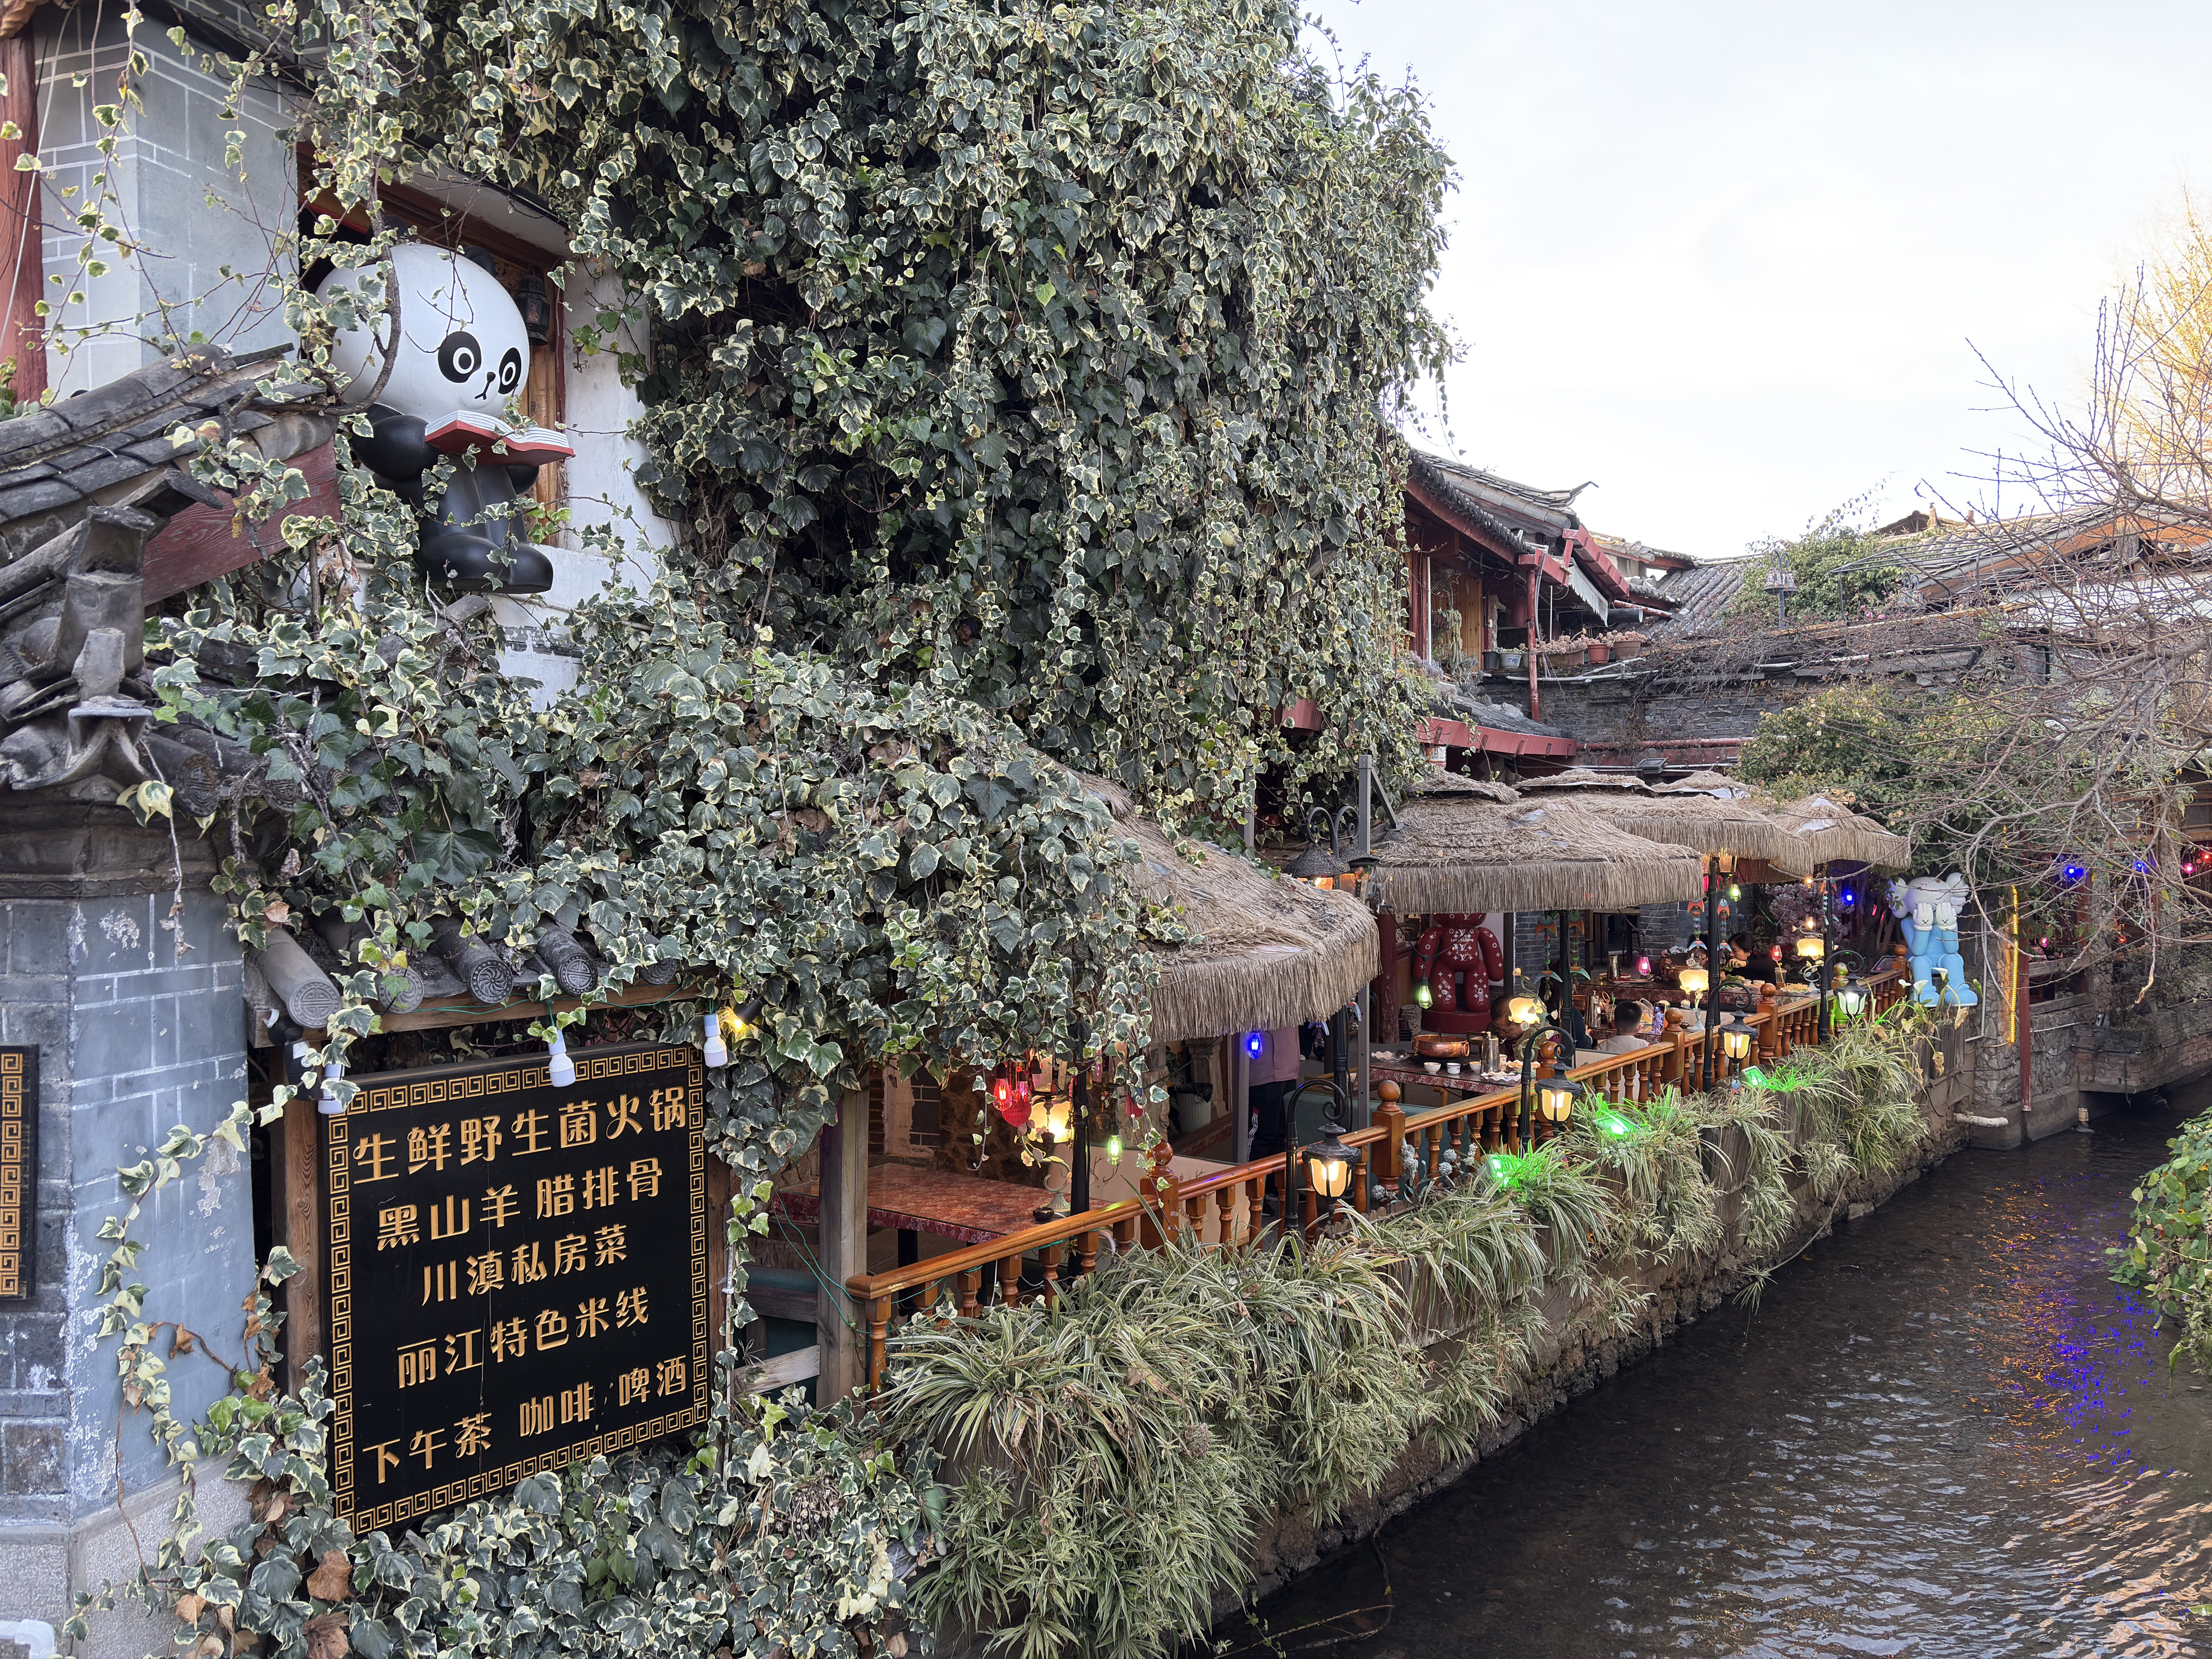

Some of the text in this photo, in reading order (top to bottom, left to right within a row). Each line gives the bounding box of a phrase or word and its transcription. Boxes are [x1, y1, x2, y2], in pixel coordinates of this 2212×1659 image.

[353, 1087, 686, 1184] 生鲜野生菌火锅
[378, 1157, 662, 1251] 黑山羊 腊排骨
[423, 1224, 627, 1306] 川滇私房菜
[397, 1286, 649, 1388] 丽江特色米线
[362, 1355, 686, 1484] 下午茶 咖啡 啤酒
